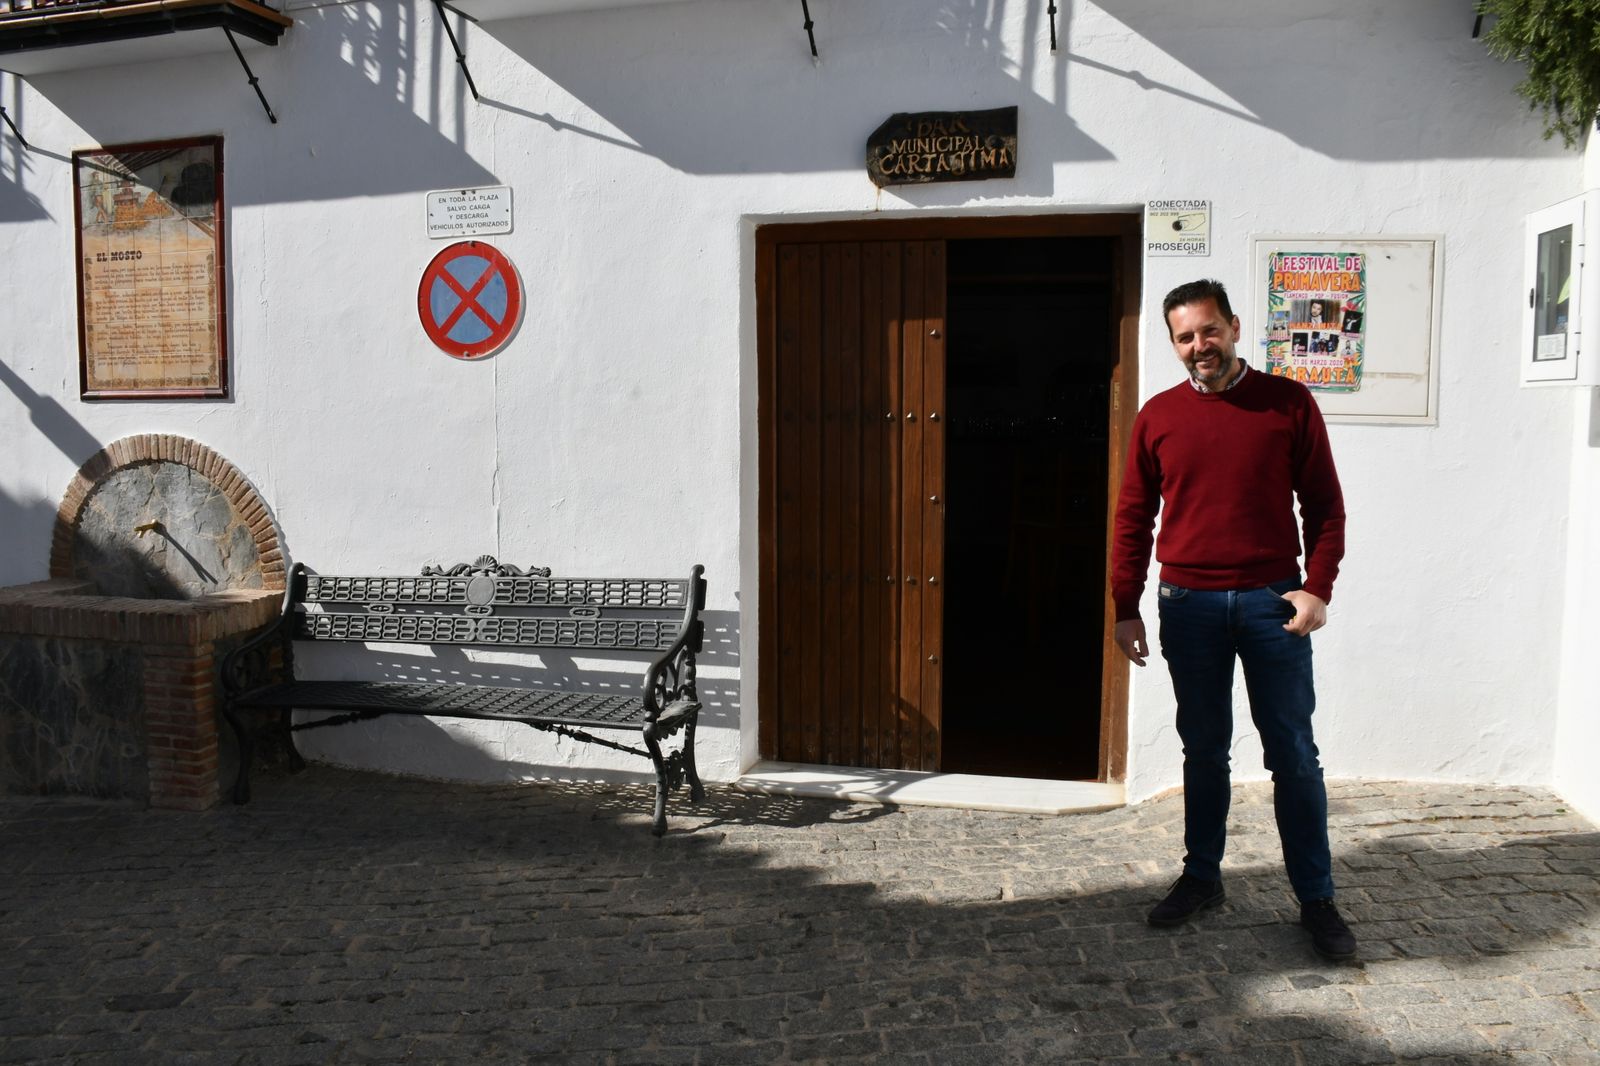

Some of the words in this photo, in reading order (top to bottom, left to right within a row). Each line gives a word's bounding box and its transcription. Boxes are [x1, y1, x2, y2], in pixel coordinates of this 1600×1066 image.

[892, 135, 981, 154] MUNICIPAL
[879, 147, 1008, 176] CARTAJIMA
[455, 212, 489, 220] DESCARGA
[430, 223, 464, 231] VEHICULOS
[466, 220, 509, 229] AUTORIZADOS
[1148, 242, 1206, 250] PROSEGUR
[96, 252, 108, 262] EL
[110, 250, 142, 262] MOSTO
[1283, 256, 1340, 271] FESTIVAL
[1345, 257, 1361, 271] DE
[1273, 271, 1361, 291] PRIMAVERA
[1272, 366, 1356, 383] PARAUTA
